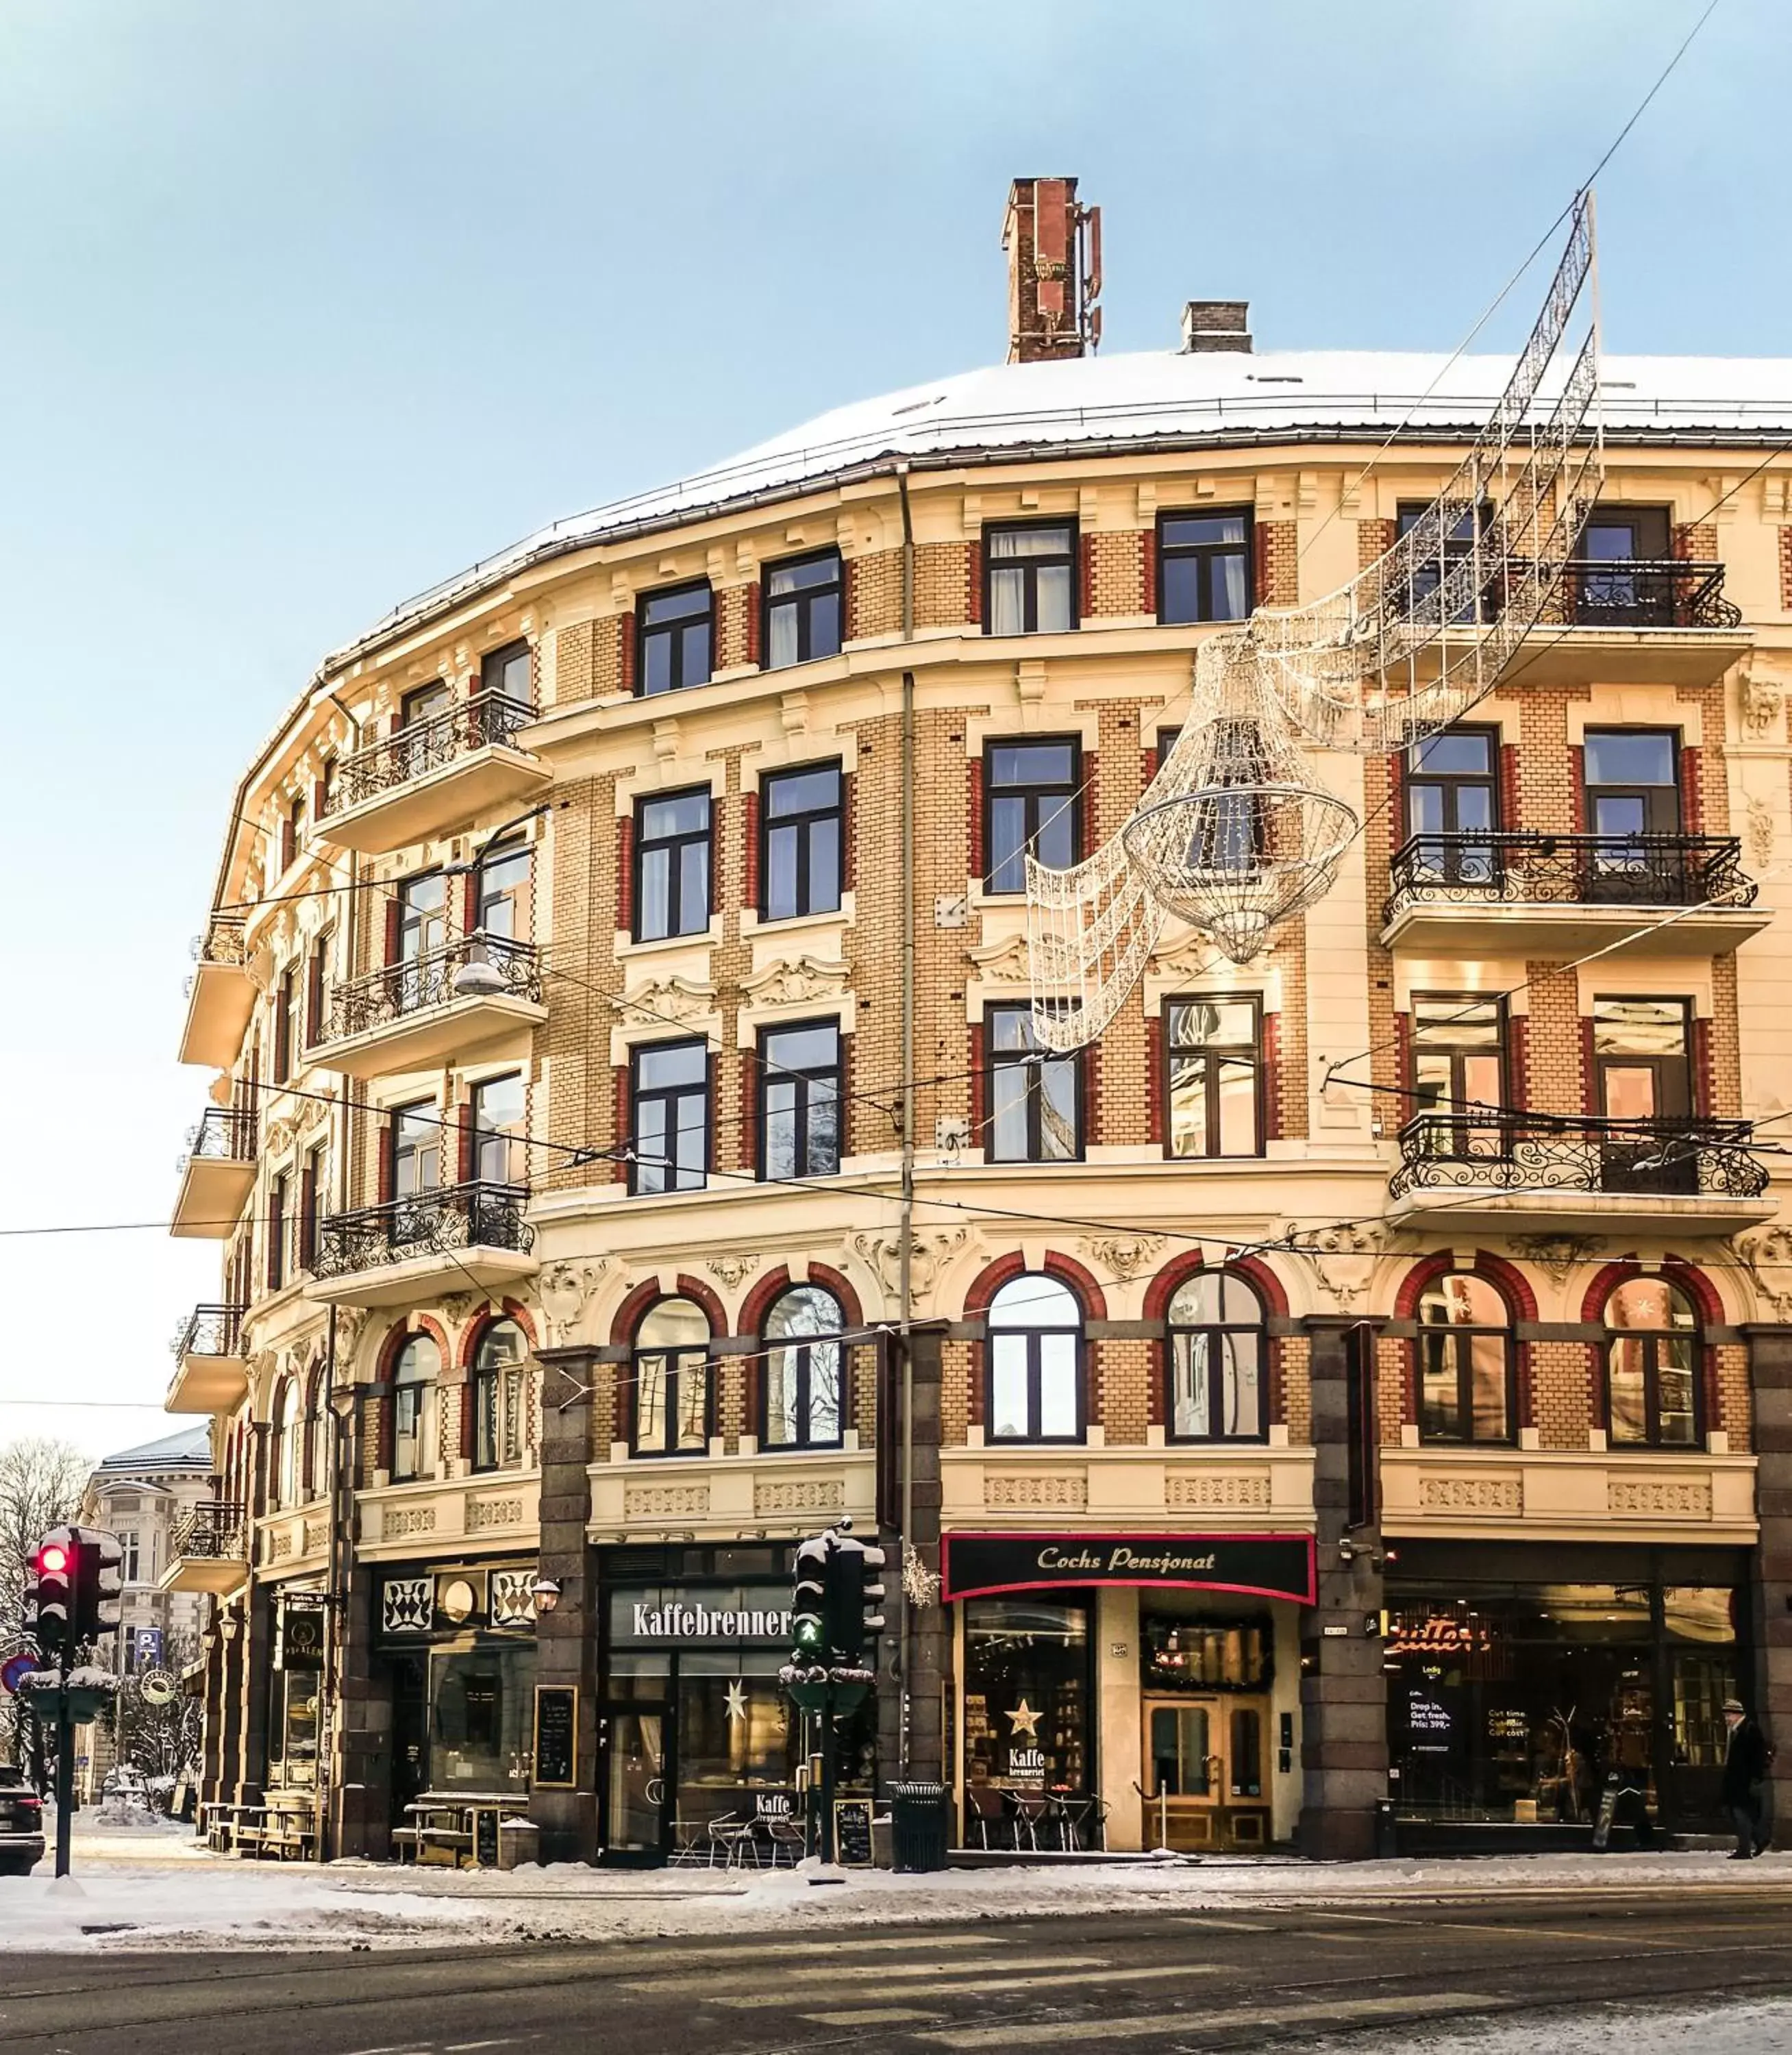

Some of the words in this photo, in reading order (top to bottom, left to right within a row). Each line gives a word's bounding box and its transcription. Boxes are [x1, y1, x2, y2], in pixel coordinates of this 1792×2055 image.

[1037, 1547, 1101, 1569] Cochs
[1108, 1547, 1216, 1574] Pensjonat
[632, 1603, 795, 1636] Kaffebrenner
[1008, 1748, 1045, 1767] Kaffe
[756, 1794, 791, 1813] Kaffe
